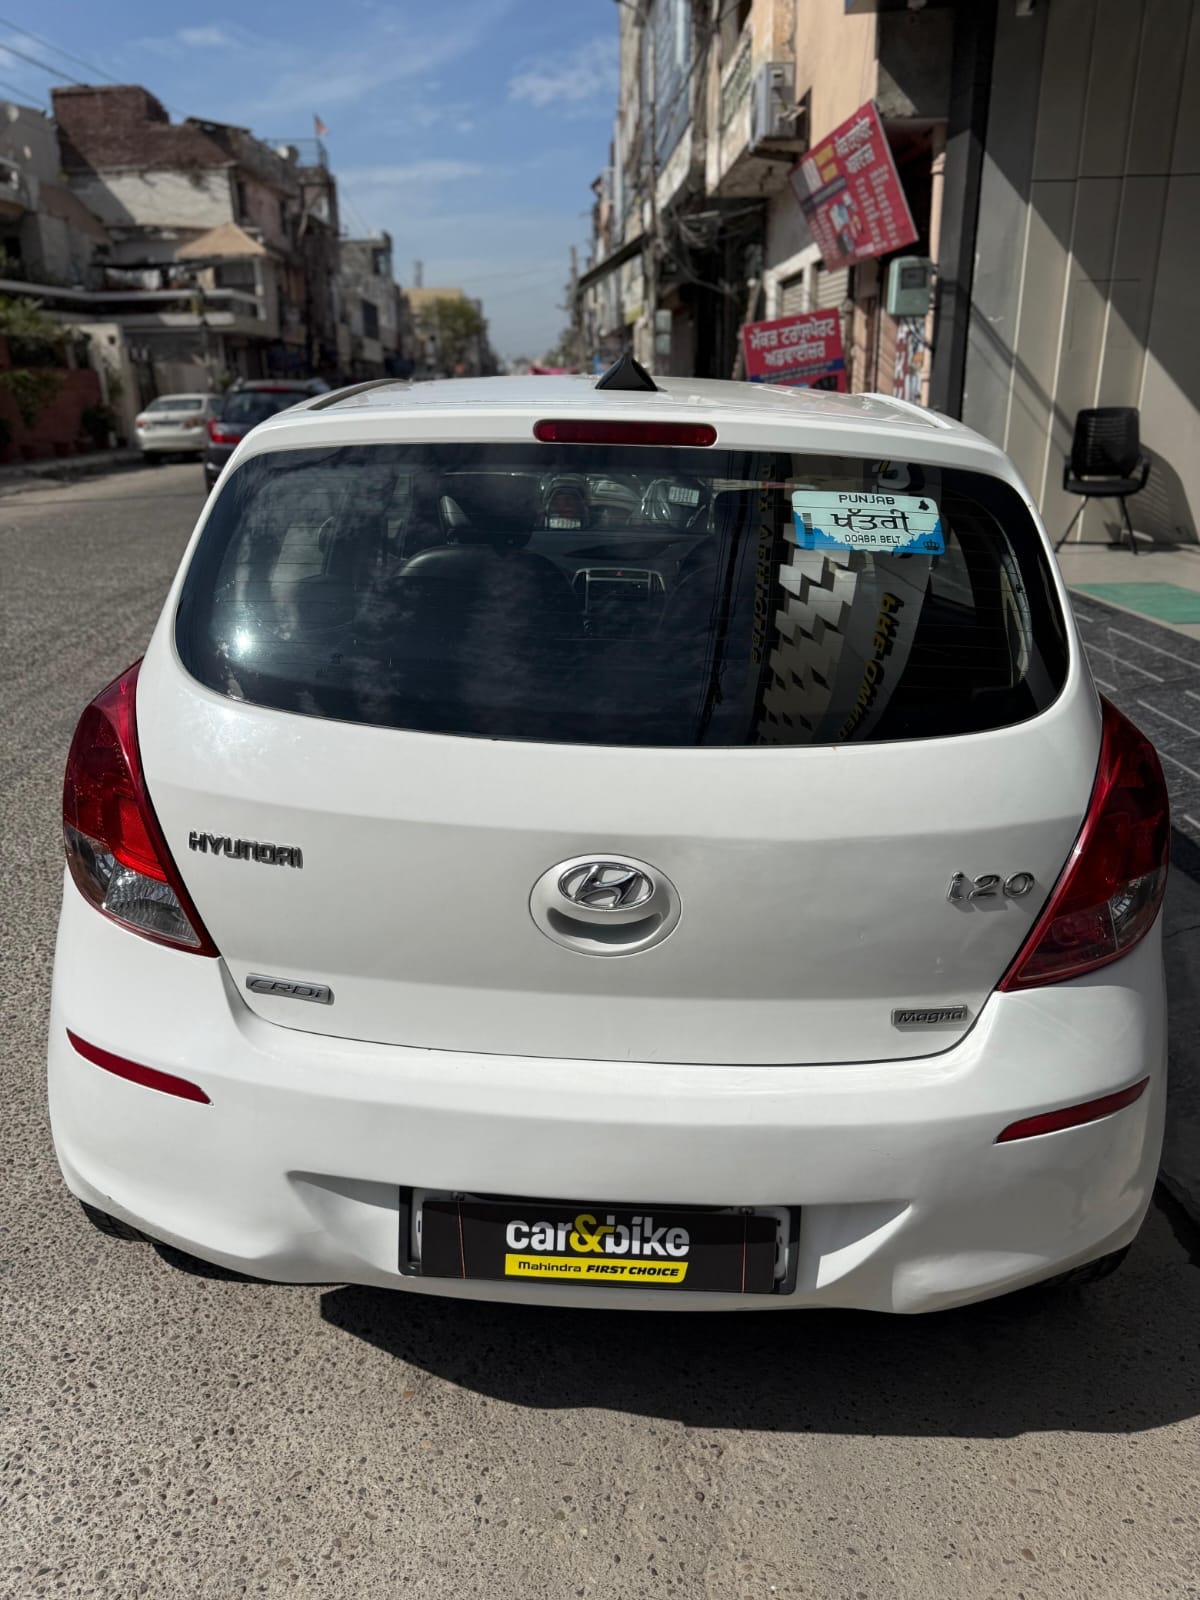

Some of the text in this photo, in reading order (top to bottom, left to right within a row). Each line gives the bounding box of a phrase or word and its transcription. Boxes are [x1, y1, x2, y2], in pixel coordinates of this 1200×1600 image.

[838, 494, 896, 505] PUNJAB
[844, 534, 901, 545] DOABA BELT
[188, 830, 304, 870] HYUNDAI
[947, 871, 1036, 903] i20
[250, 979, 324, 998] CRDi
[898, 1009, 963, 1024] Magna
[505, 1213, 691, 1257] car&bike
[518, 1260, 680, 1277] Mahindra FIRST CHOICE
